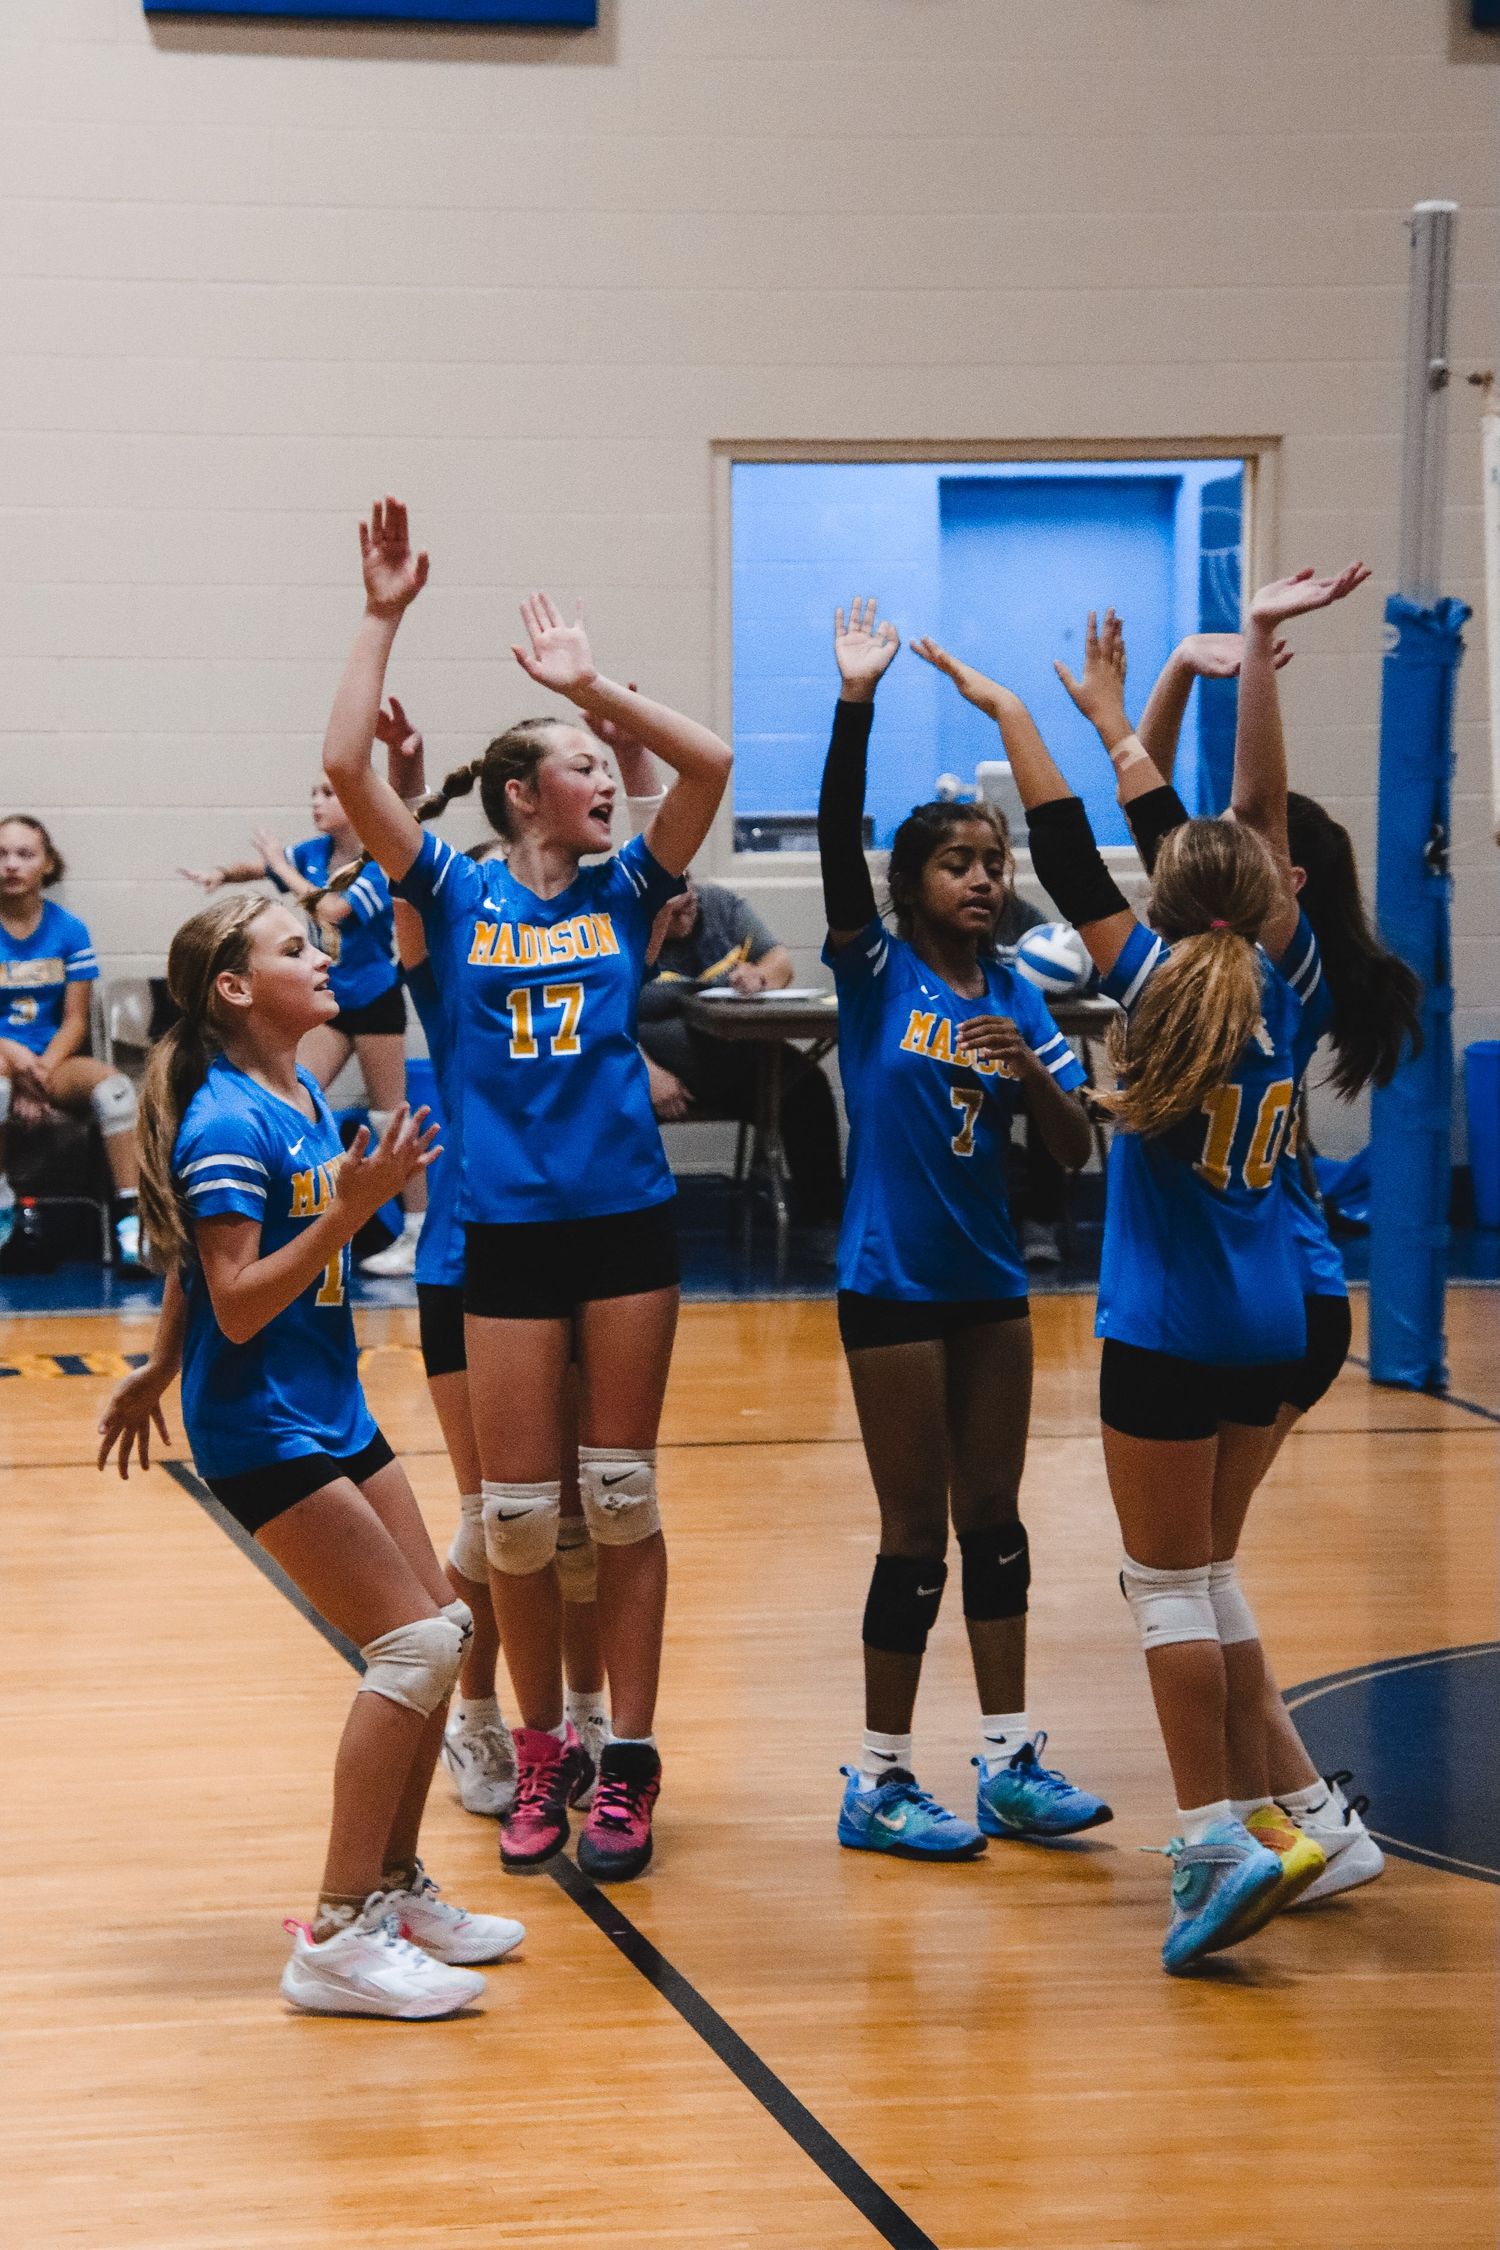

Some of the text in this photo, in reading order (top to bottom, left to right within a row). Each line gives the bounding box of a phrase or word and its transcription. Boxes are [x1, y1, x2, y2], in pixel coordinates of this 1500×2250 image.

[467, 912, 621, 968] MADISON
[506, 982, 584, 1059] 17
[950, 1086, 984, 1157] 7
